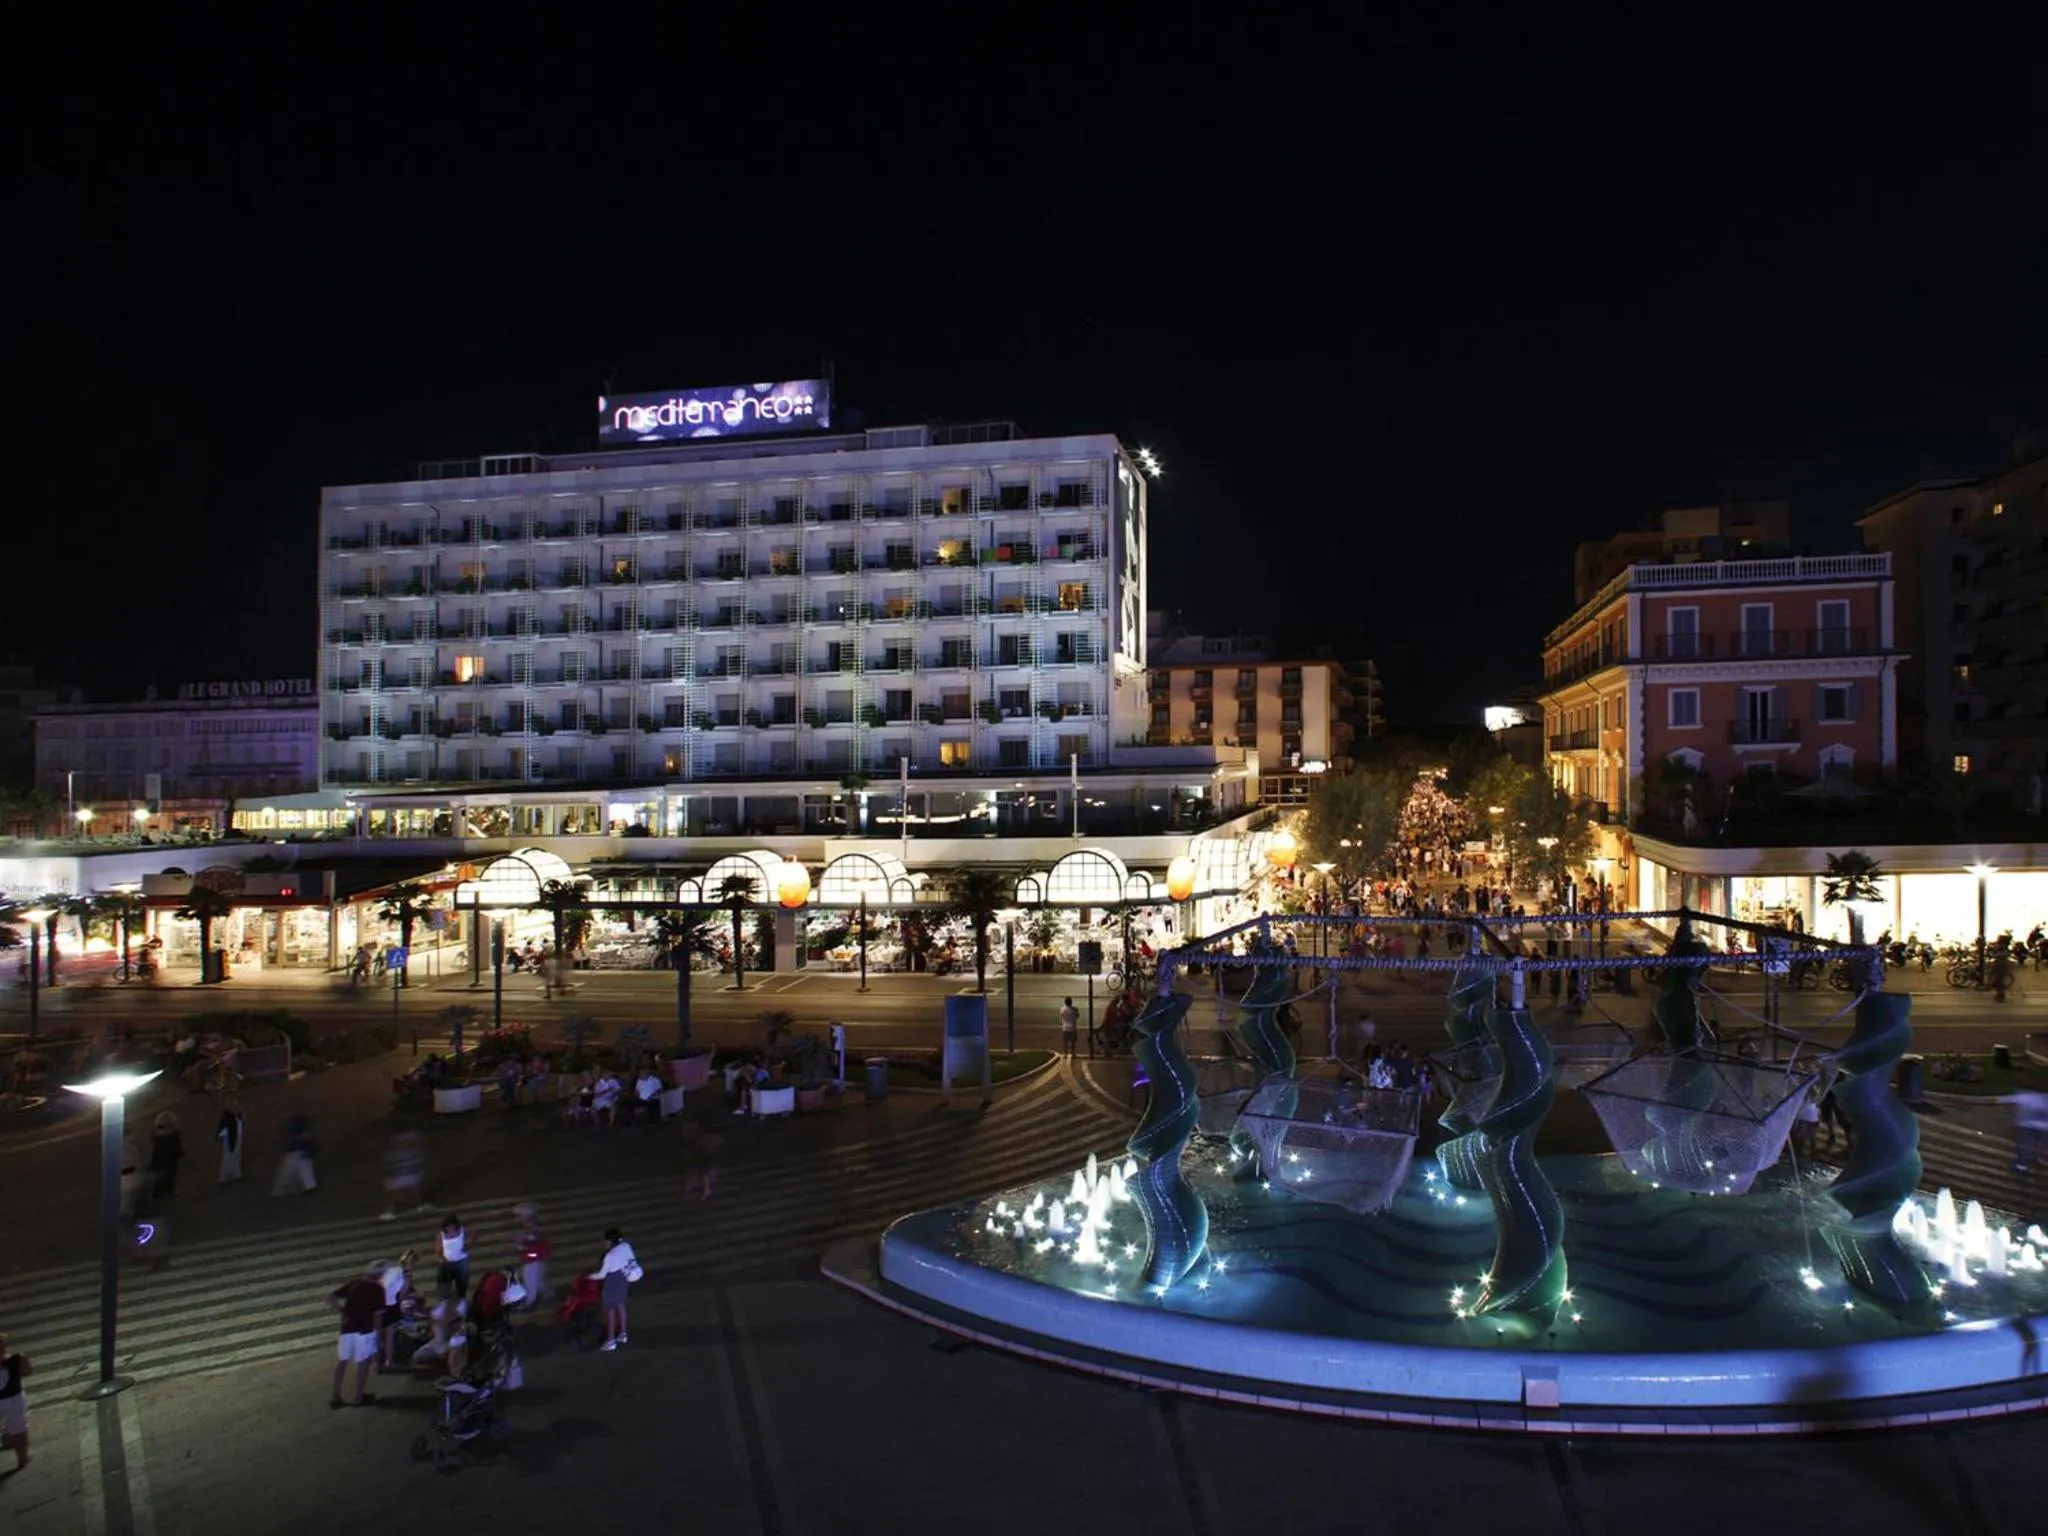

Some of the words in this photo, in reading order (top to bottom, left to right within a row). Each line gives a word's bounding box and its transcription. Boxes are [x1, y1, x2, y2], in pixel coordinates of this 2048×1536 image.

[188, 682, 206, 698] LE
[208, 679, 261, 697] GRAND
[265, 678, 313, 695] HOTEL
